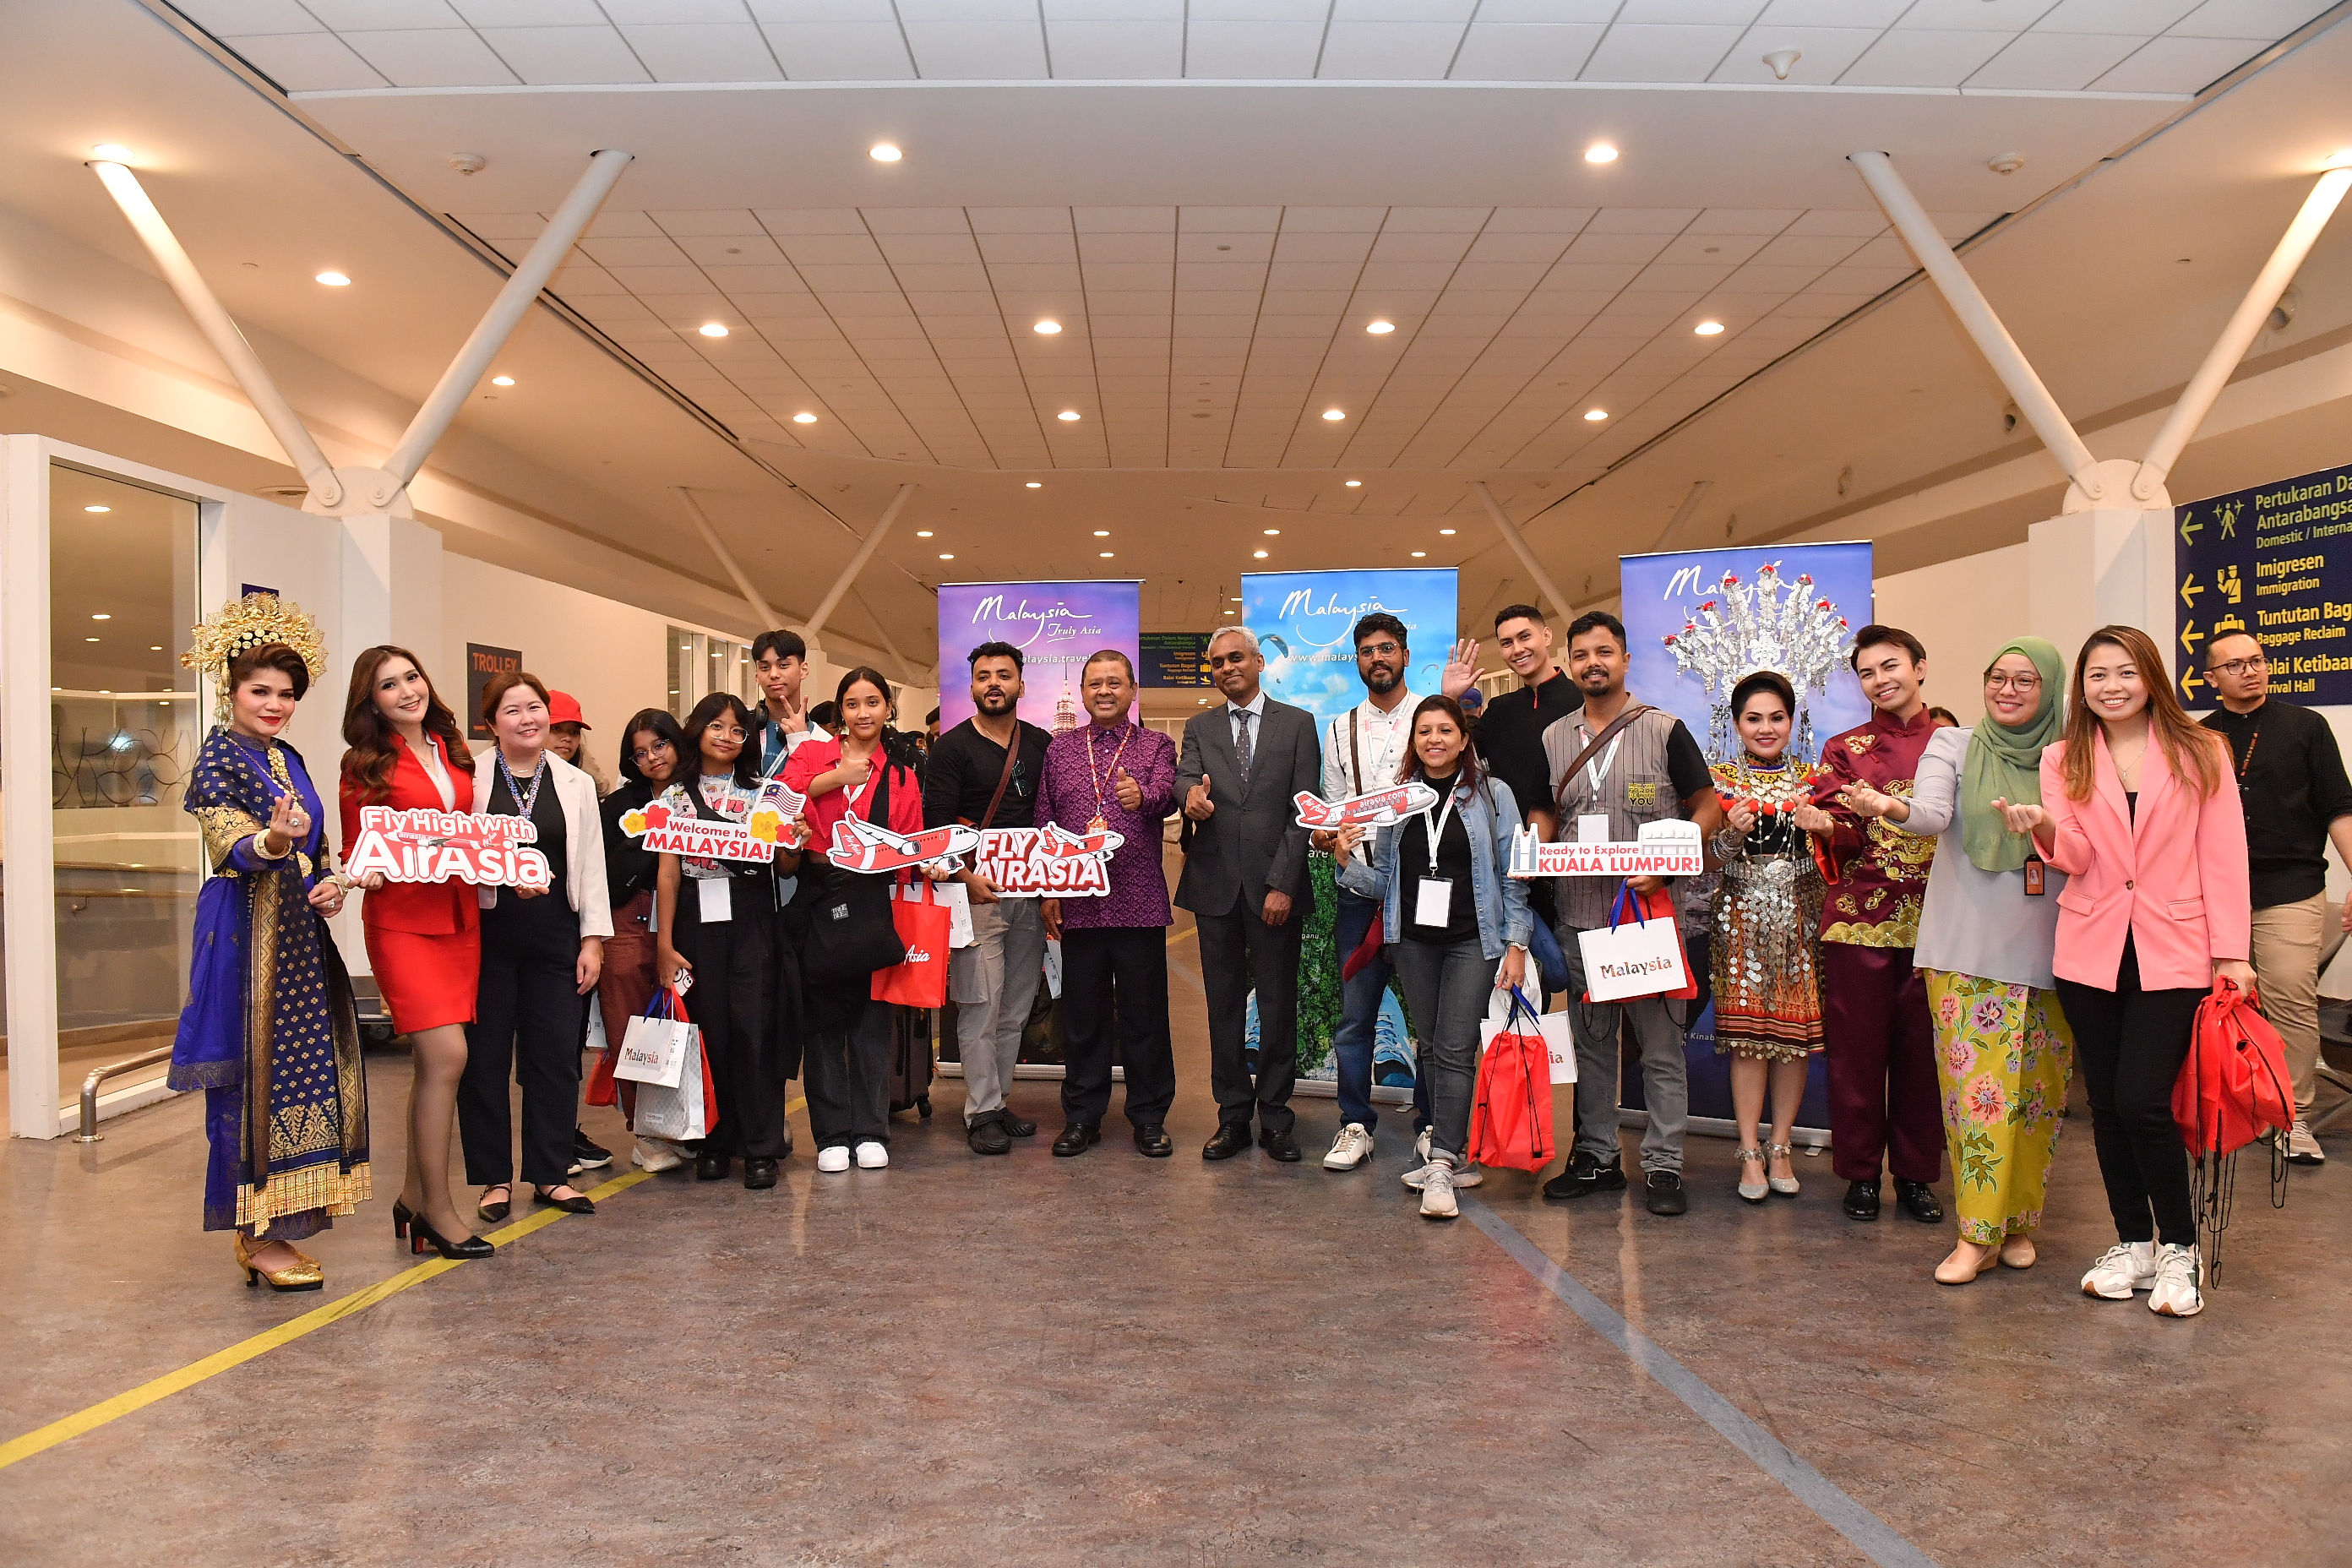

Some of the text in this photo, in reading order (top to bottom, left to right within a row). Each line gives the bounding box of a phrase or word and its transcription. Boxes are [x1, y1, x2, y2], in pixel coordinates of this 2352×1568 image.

[2256, 482, 2332, 510] Pertukaran
[2257, 528, 2303, 549] Domestic
[2312, 521, 2352, 538] Interna
[2257, 554, 2324, 579] Imigresen
[2257, 577, 2320, 596] Immigration
[972, 594, 1092, 649] Malaysia
[1279, 588, 1408, 647] Malaysia
[2257, 602, 2352, 626] Tuntutan Bag
[1047, 623, 1102, 640] Truly Asia
[2257, 624, 2346, 647] Baggage Reclaim
[473, 652, 518, 674] TROLLEY
[2268, 656, 2289, 676] alai
[2266, 678, 2317, 694] rrival Hall
[1359, 791, 1406, 808] airasia.com
[1630, 798, 1654, 806] YOU
[366, 809, 407, 831] Fly
[412, 812, 471, 836] High
[476, 815, 535, 841] With
[669, 820, 748, 839] Welcome to
[646, 831, 771, 862] MALAYSIA!
[980, 831, 1038, 862] FLY
[1539, 845, 1639, 858] Ready to Explore
[976, 858, 1103, 890] AIRASIA
[1538, 857, 1701, 873] KUALA LUMPUR!
[904, 944, 930, 966] Asia
[1599, 956, 1673, 979] Malaysia
[1690, 1032, 1715, 1042] Kinab
[623, 1047, 660, 1065] Malaysia
